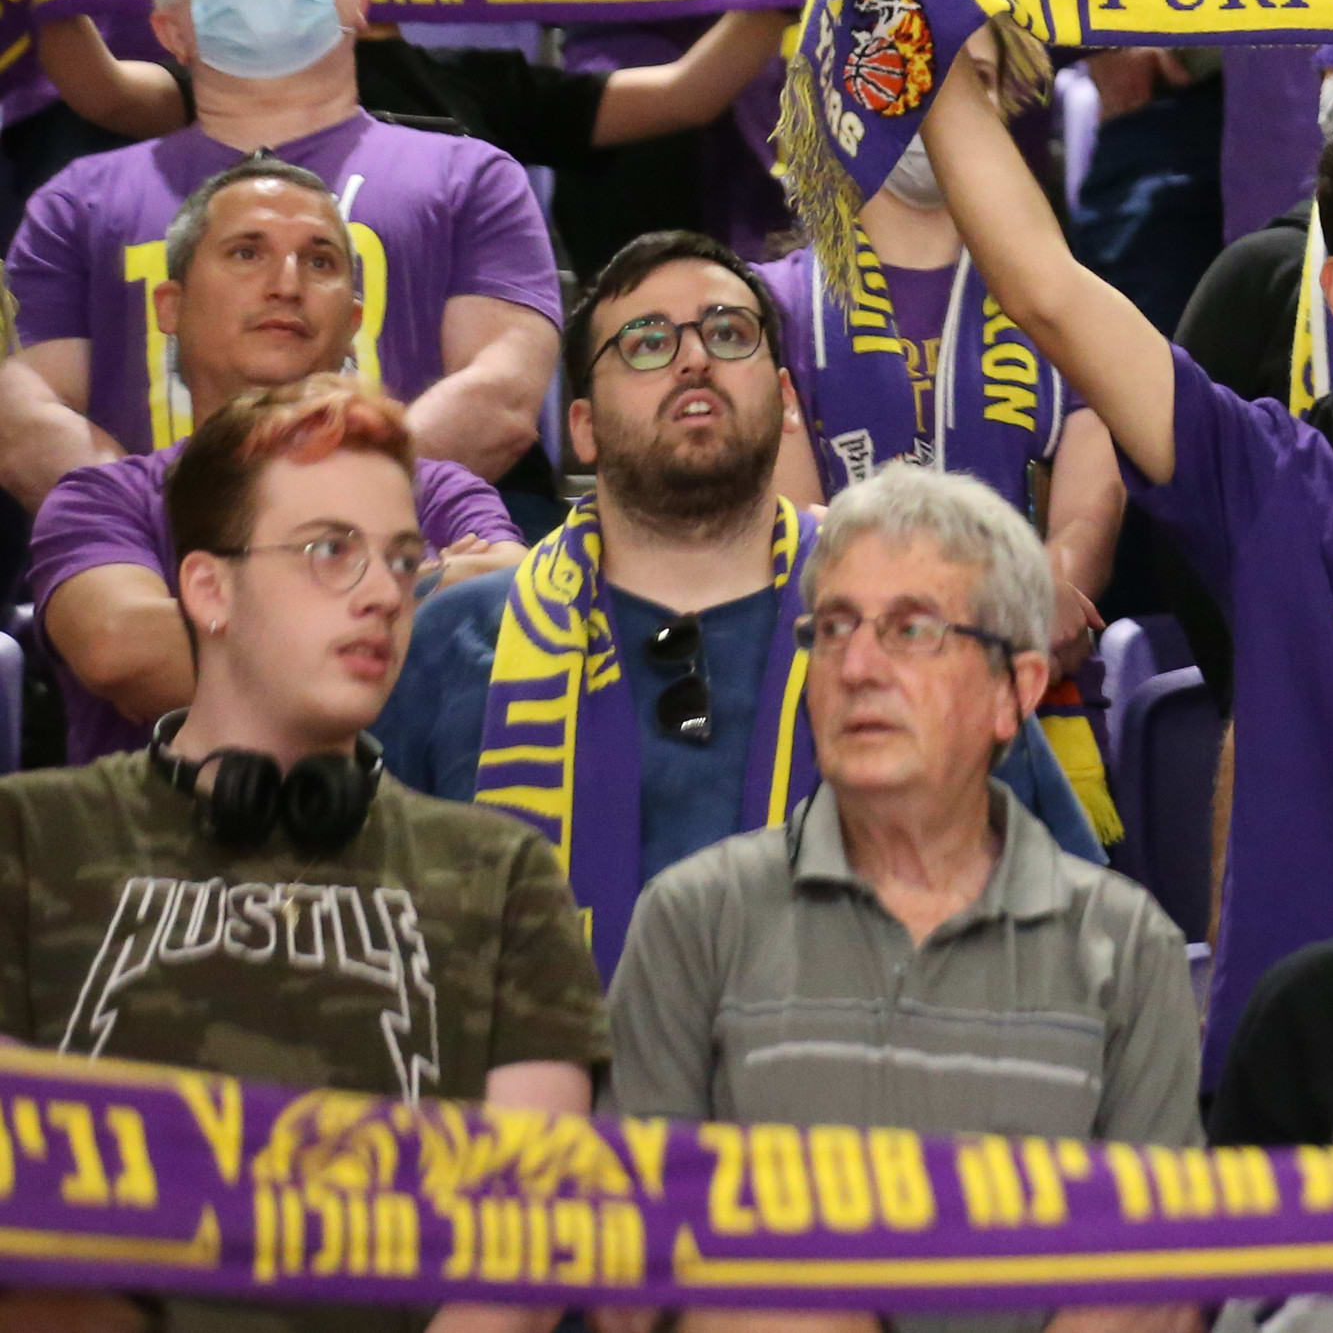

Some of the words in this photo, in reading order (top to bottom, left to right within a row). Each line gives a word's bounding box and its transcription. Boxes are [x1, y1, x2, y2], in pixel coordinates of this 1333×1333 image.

[982, 294, 1038, 433] LON
[58, 877, 440, 1107] HUSTLE
[701, 1124, 935, 1236] 2008
